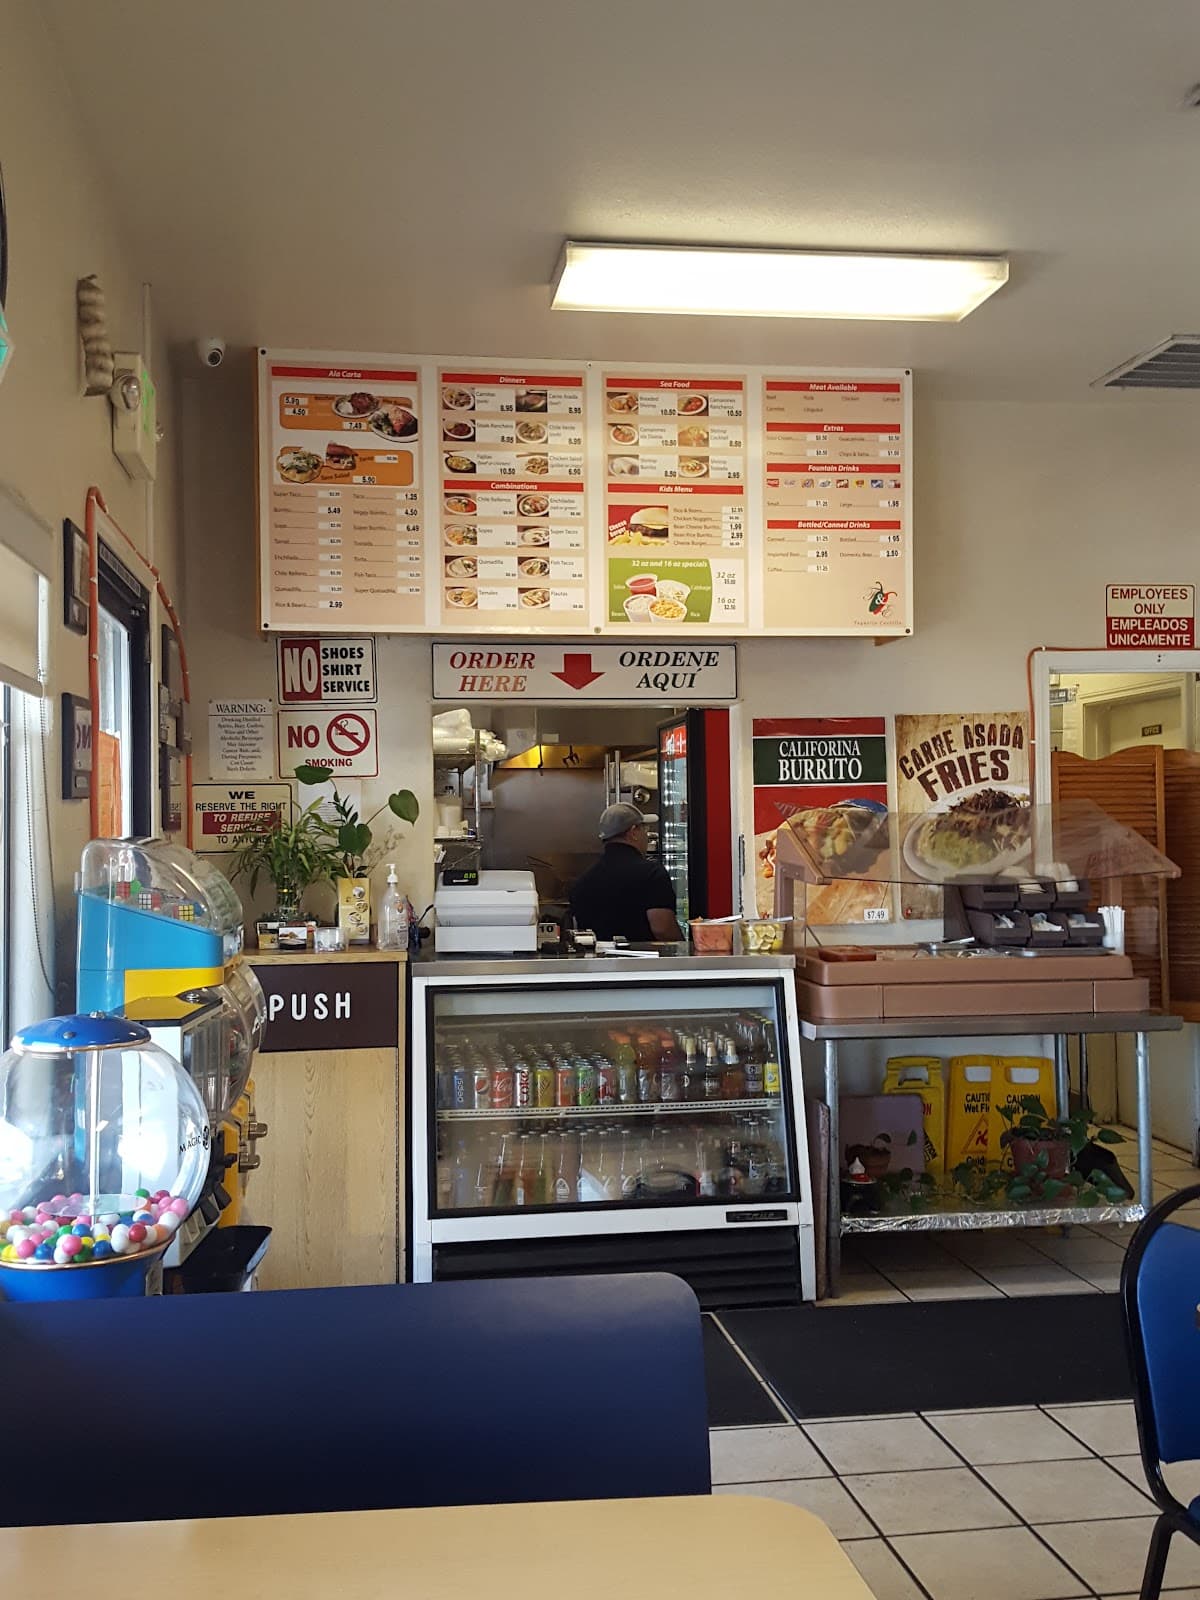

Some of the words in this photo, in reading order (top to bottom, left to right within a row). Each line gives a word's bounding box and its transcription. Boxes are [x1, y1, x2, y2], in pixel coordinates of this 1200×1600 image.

[490, 482, 538, 490] Combinations
[798, 521, 848, 529] Bottled/Canned
[849, 521, 870, 529] Drinks
[1111, 588, 1188, 600] EMPLOYEES
[1134, 603, 1166, 615] ONLY
[1111, 619, 1189, 631] EMPLEADOS
[1109, 634, 1191, 646] UNICAMENTE
[321, 647, 364, 659] SHOES
[450, 651, 536, 669] ORDER
[619, 651, 720, 668] ORDENE
[283, 647, 319, 694] NO
[322, 664, 362, 676] SHIRT
[323, 680, 370, 693] SERVICE
[458, 675, 528, 693] HERE
[216, 703, 266, 713] WARNING:
[287, 725, 320, 749] NO
[962, 722, 1024, 750] ASADA
[778, 739, 861, 758] CALIFORINA
[304, 758, 353, 768] SMOKING
[778, 757, 863, 782] BURRITO
[917, 749, 1010, 801] FRIES
[228, 791, 255, 800] WE
[195, 803, 236, 812] RESERVE
[240, 802, 257, 810] THE
[261, 802, 287, 810] RIGHT
[213, 813, 227, 822] TO
[230, 813, 272, 822] REFUSE
[217, 835, 228, 844] TO
[269, 992, 351, 1021] PUSH
